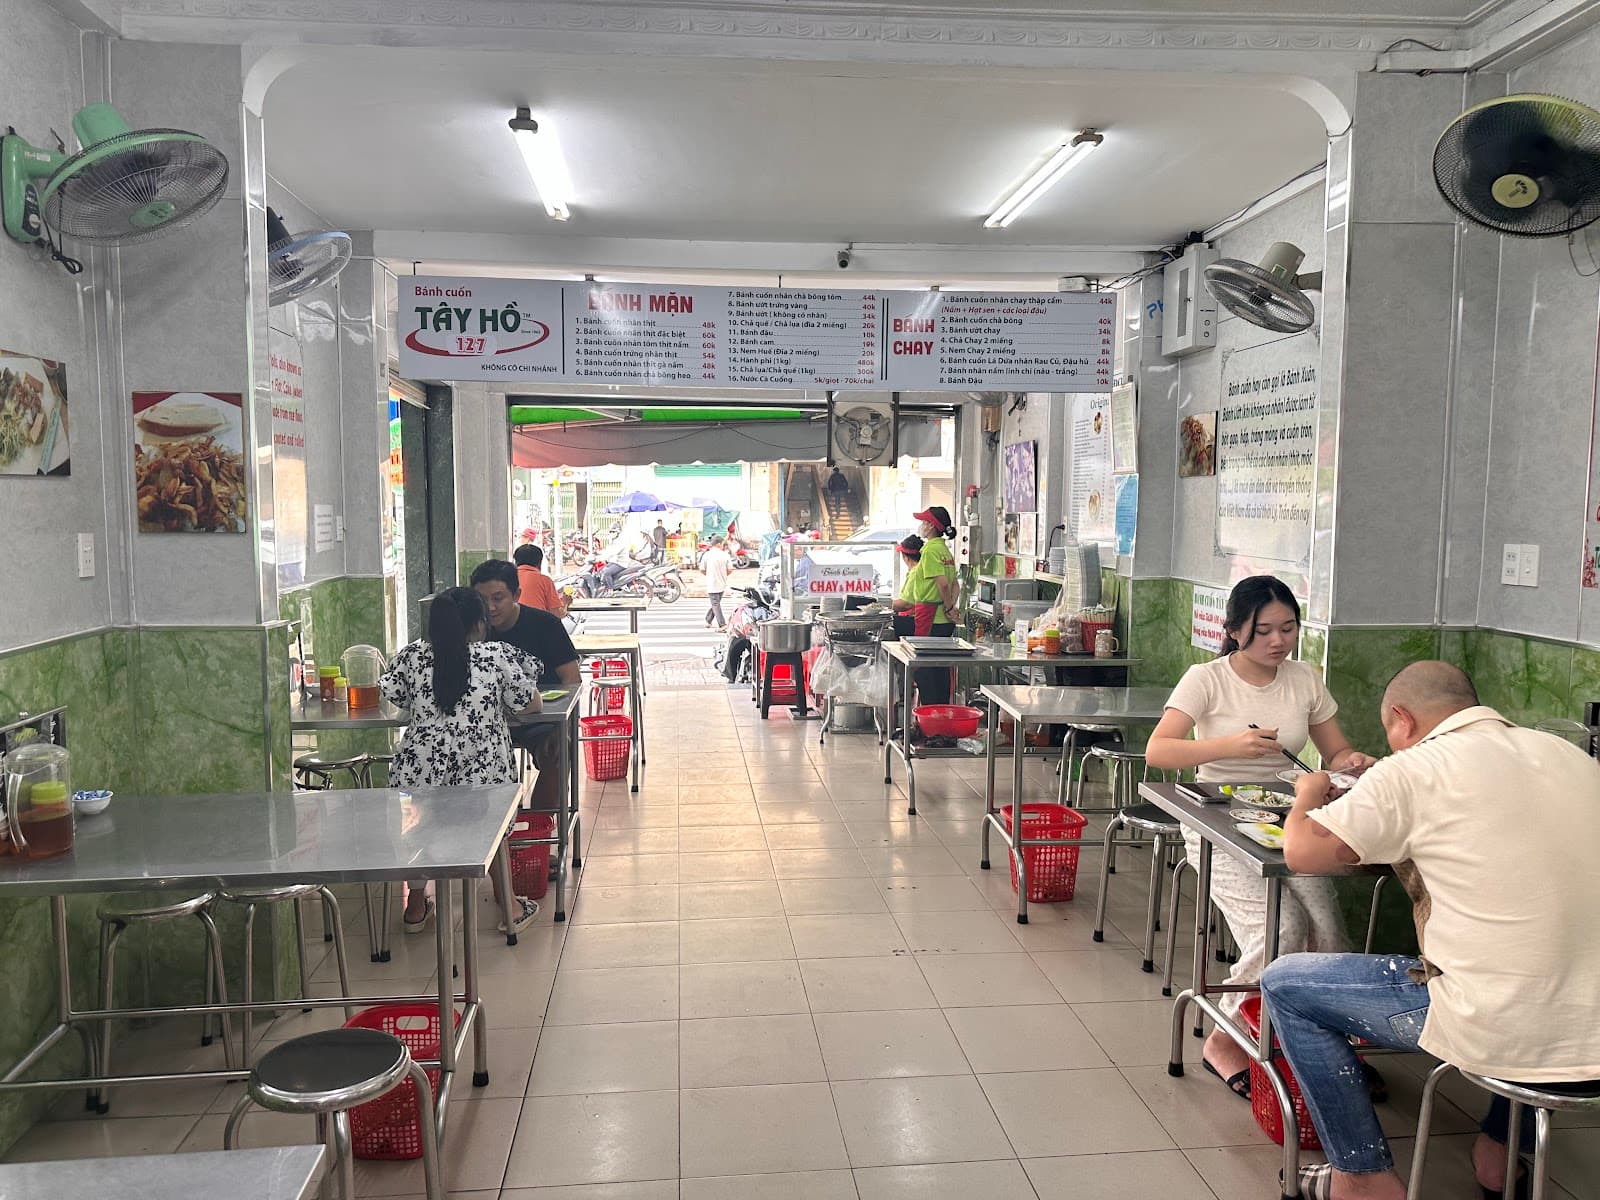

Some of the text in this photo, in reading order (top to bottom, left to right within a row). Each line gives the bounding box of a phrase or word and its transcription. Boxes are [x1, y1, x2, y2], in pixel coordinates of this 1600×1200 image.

[415, 286, 472, 298] Bánh cuốn
[756, 291, 773, 299] cuốn
[649, 291, 693, 317] MẶN
[1010, 296, 1028, 305] chay
[1028, 297, 1046, 306] thập
[415, 301, 472, 333] TÂY
[480, 301, 521, 334] HỒ
[584, 316, 602, 324] Bánh
[774, 310, 796, 320] không
[893, 313, 935, 333] BÁNH
[584, 327, 602, 335] Bánh
[984, 326, 1001, 335] chay
[456, 337, 486, 353] 127
[584, 338, 603, 346] Bánh
[964, 336, 983, 344] Chay
[584, 348, 603, 356] Bánh
[604, 348, 622, 356] cuốn
[893, 340, 934, 355] CHAY
[967, 347, 986, 355] Chay
[576, 358, 583, 366] 5.
[584, 358, 603, 366] Bánh
[604, 358, 622, 367] cuốn
[481, 363, 507, 372] KHÔNG
[508, 364, 518, 372] CÓ
[532, 364, 558, 373] NHÁNH
[584, 368, 603, 376] Bánh
[604, 369, 622, 377] cuốn
[677, 371, 692, 380] heo
[1228, 381, 1240, 397] Bánh
[1240, 376, 1252, 395] cuốn
[1252, 378, 1260, 396] hay
[1262, 377, 1271, 391] còn
[1287, 368, 1300, 386] Bánh
[810, 580, 838, 592] CHAY
